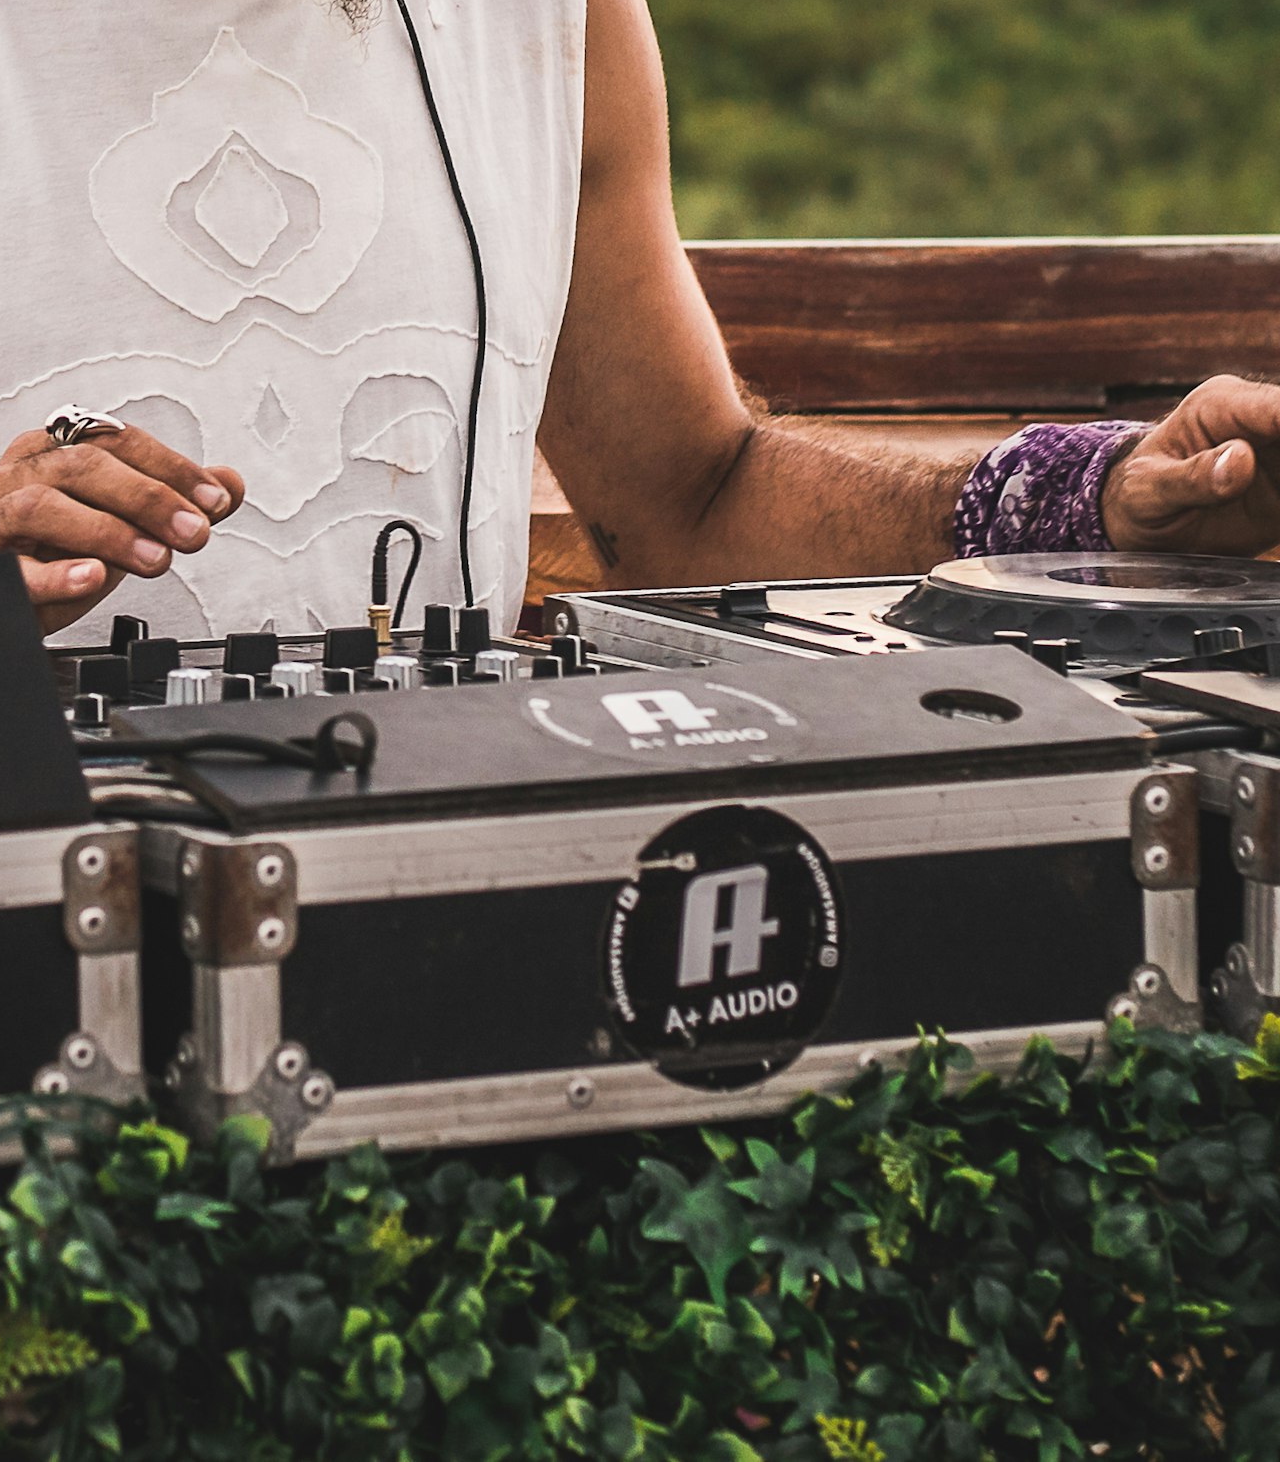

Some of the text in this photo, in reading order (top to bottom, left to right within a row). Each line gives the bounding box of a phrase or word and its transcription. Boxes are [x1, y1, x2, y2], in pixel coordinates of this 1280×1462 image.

[675, 727, 769, 747] AUDIO
[665, 981, 799, 1035] A+ AUDIO
